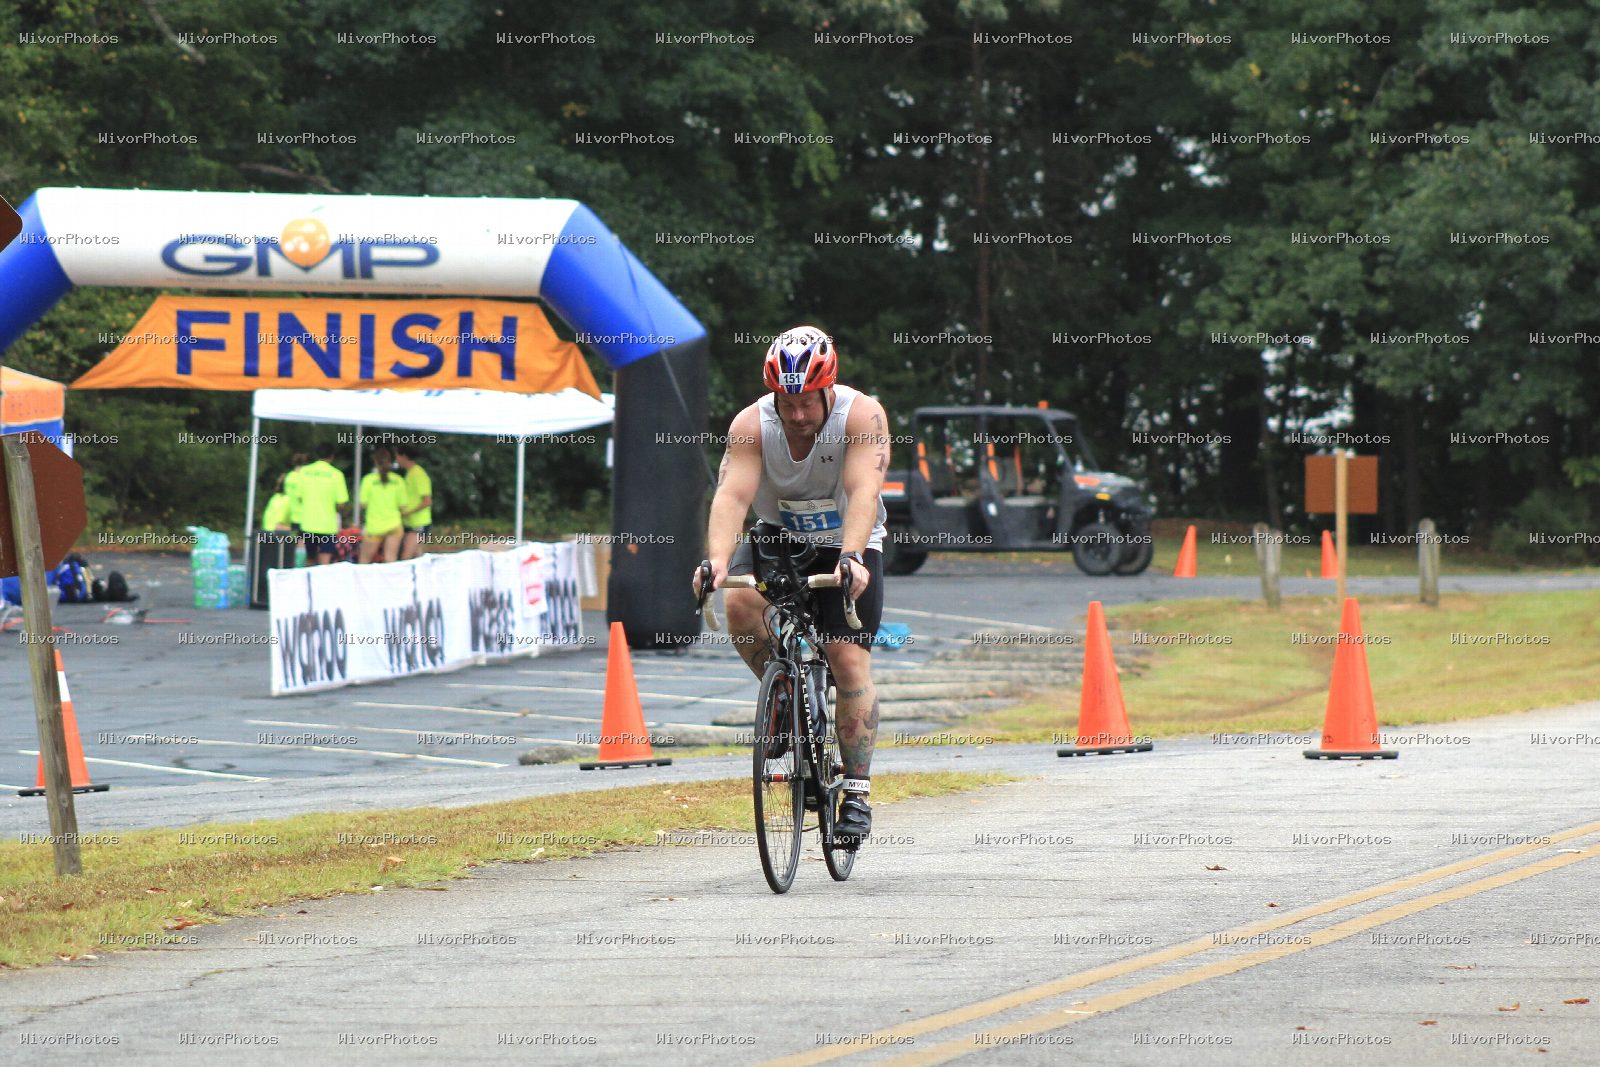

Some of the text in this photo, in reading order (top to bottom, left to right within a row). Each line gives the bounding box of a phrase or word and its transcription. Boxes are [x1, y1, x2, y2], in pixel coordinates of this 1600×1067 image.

[161, 234, 440, 280] GMP
[176, 310, 518, 381] FINISH
[783, 373, 800, 384] 151
[790, 513, 828, 531] 151
